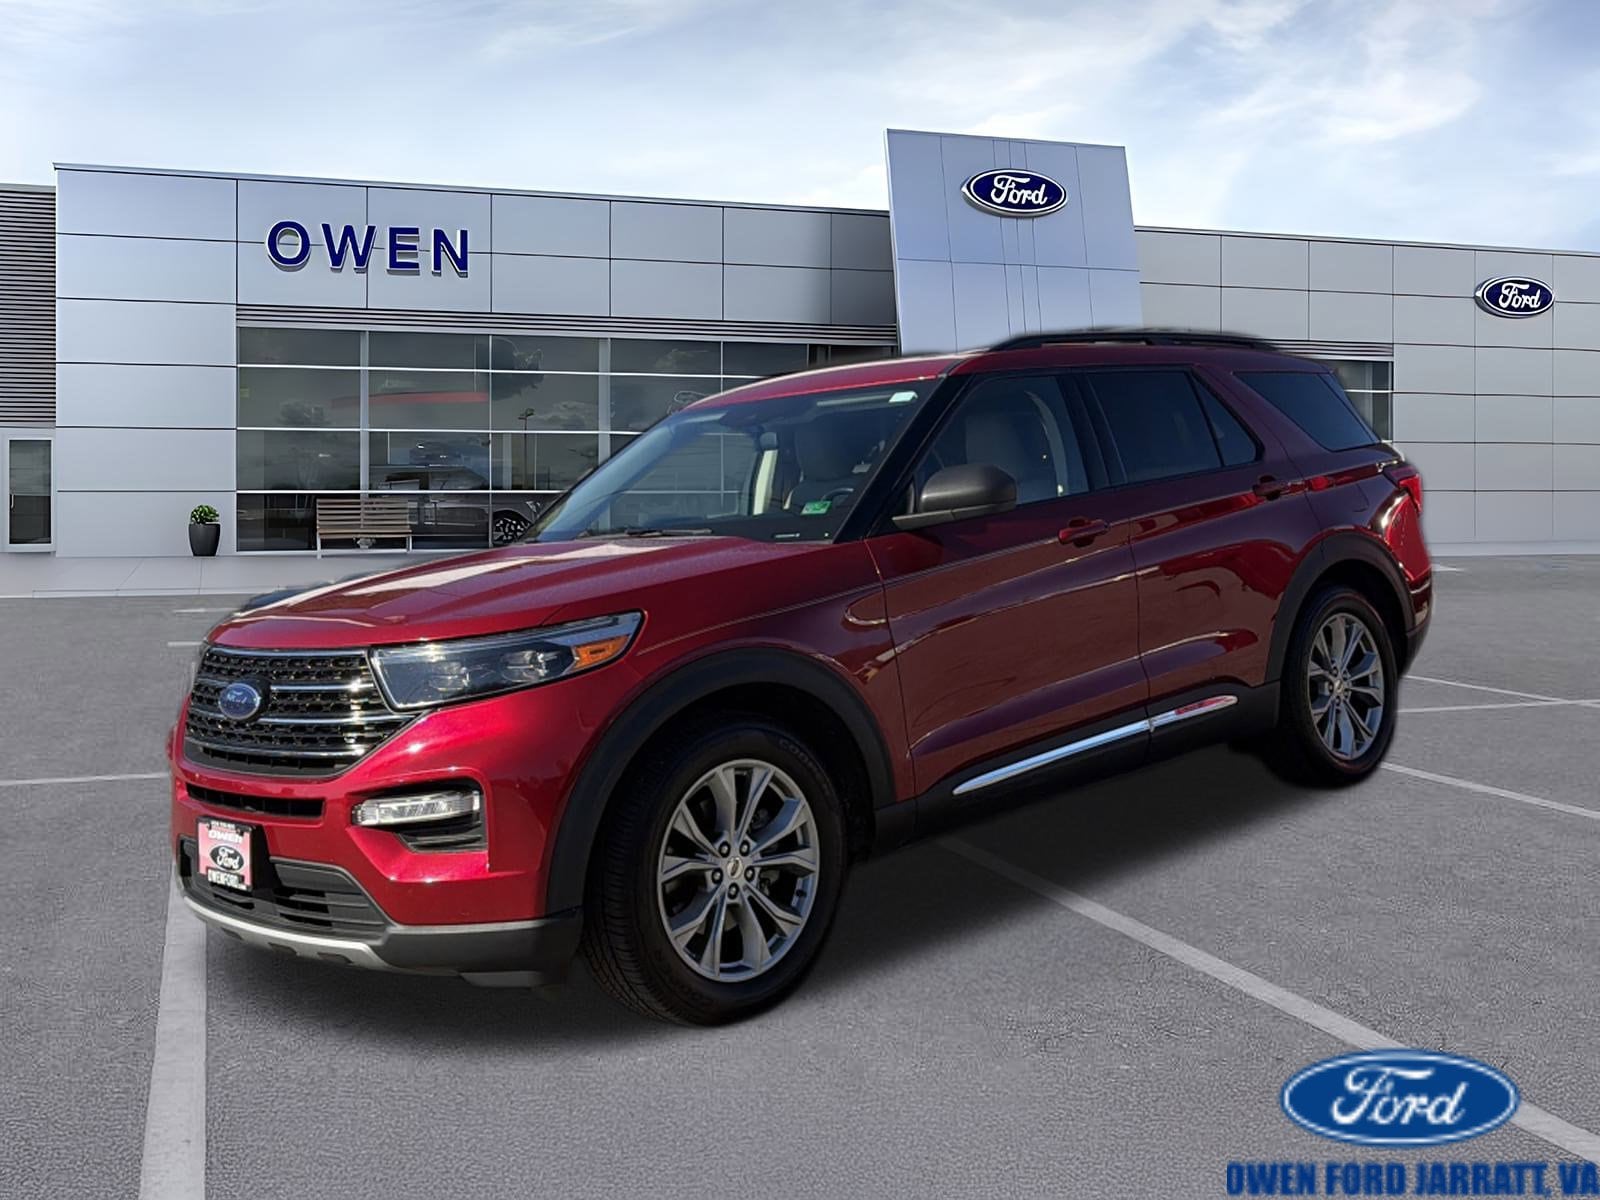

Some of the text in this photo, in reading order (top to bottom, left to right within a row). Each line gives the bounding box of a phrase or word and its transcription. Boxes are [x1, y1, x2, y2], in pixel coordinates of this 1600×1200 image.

[990, 174, 1048, 206] Ford
[266, 219, 469, 276] OWEN
[1498, 282, 1542, 309] Ford
[208, 828, 243, 844] OWEN
[216, 846, 240, 869] Ford
